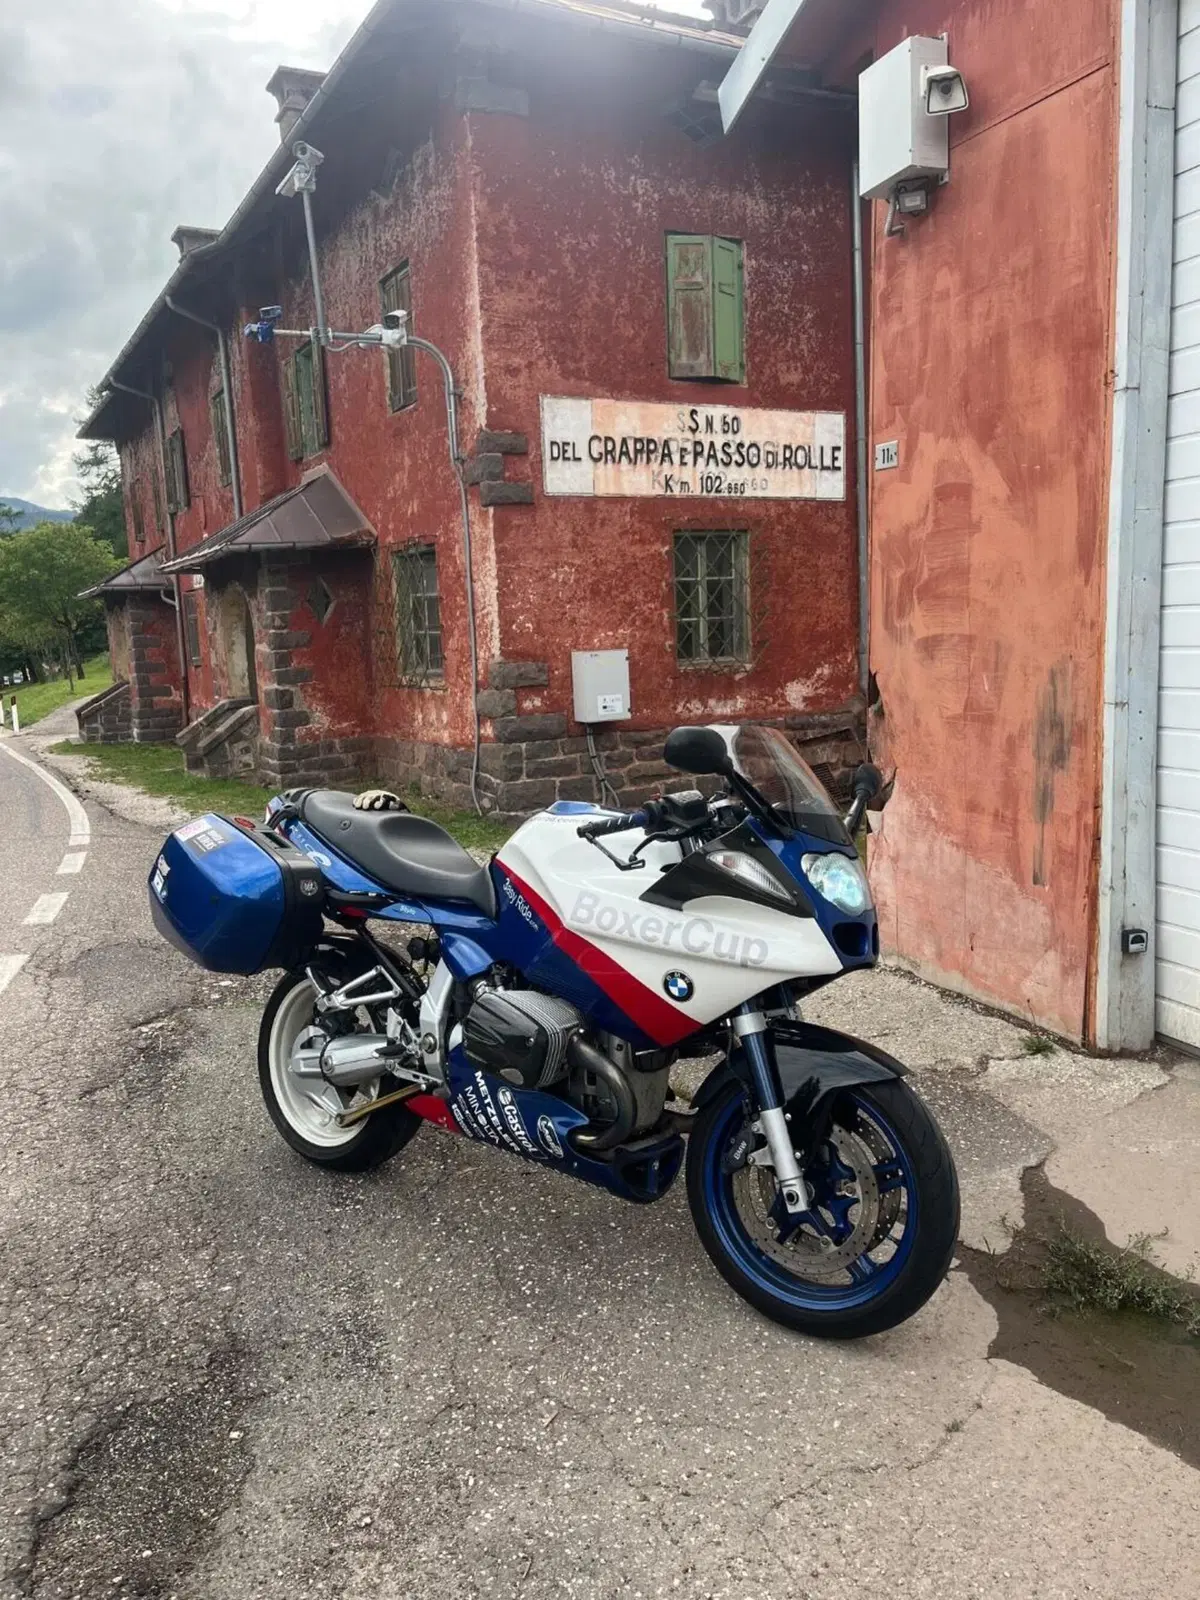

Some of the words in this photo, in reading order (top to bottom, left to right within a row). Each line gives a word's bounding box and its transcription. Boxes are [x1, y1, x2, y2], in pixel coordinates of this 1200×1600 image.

[722, 415, 740, 434] 50
[550, 440, 582, 462] DEL
[588, 434, 674, 468] GRAPPA
[679, 446, 689, 467] E
[692, 440, 761, 468] PASSO
[782, 444, 842, 471] ROLLE
[569, 890, 769, 967] BoxerCup
[464, 1085, 500, 1144] MINOLTA
[474, 1070, 521, 1152] METZELER
[503, 1104, 539, 1153] Castrol
[733, 1140, 747, 1160] BMW
